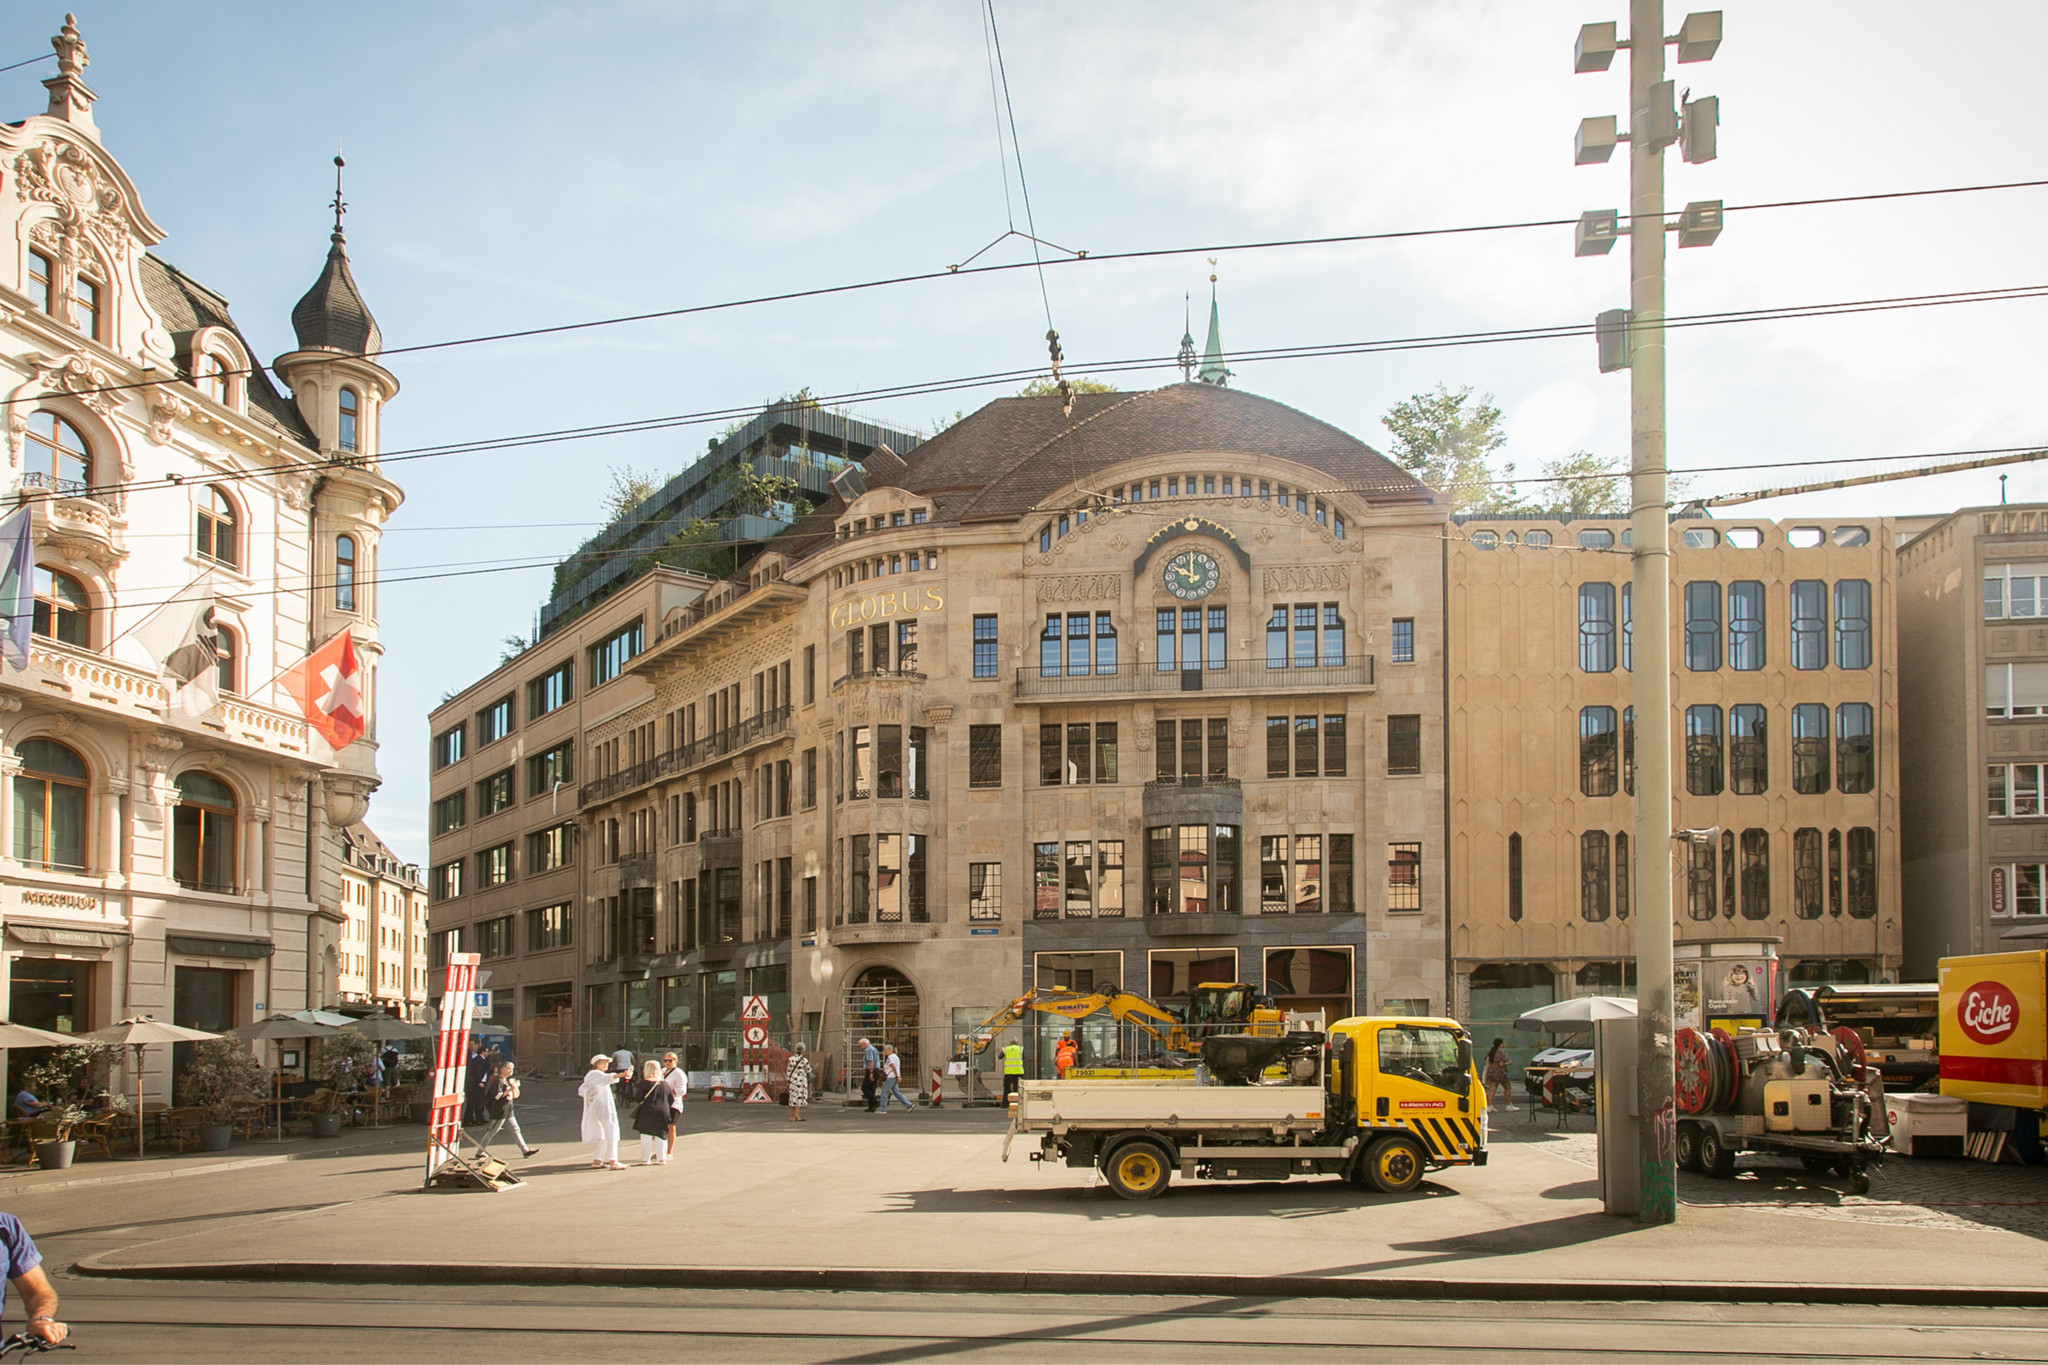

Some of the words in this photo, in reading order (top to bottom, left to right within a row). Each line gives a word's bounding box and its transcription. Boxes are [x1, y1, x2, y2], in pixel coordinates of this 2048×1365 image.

[830, 587, 944, 629] GLOBUS
[1995, 871, 2003, 909] BASILISK
[55, 932, 90, 941] BOHEMIA
[1964, 991, 2012, 1034] Eiche
[1075, 1069, 1096, 1077] 75021
